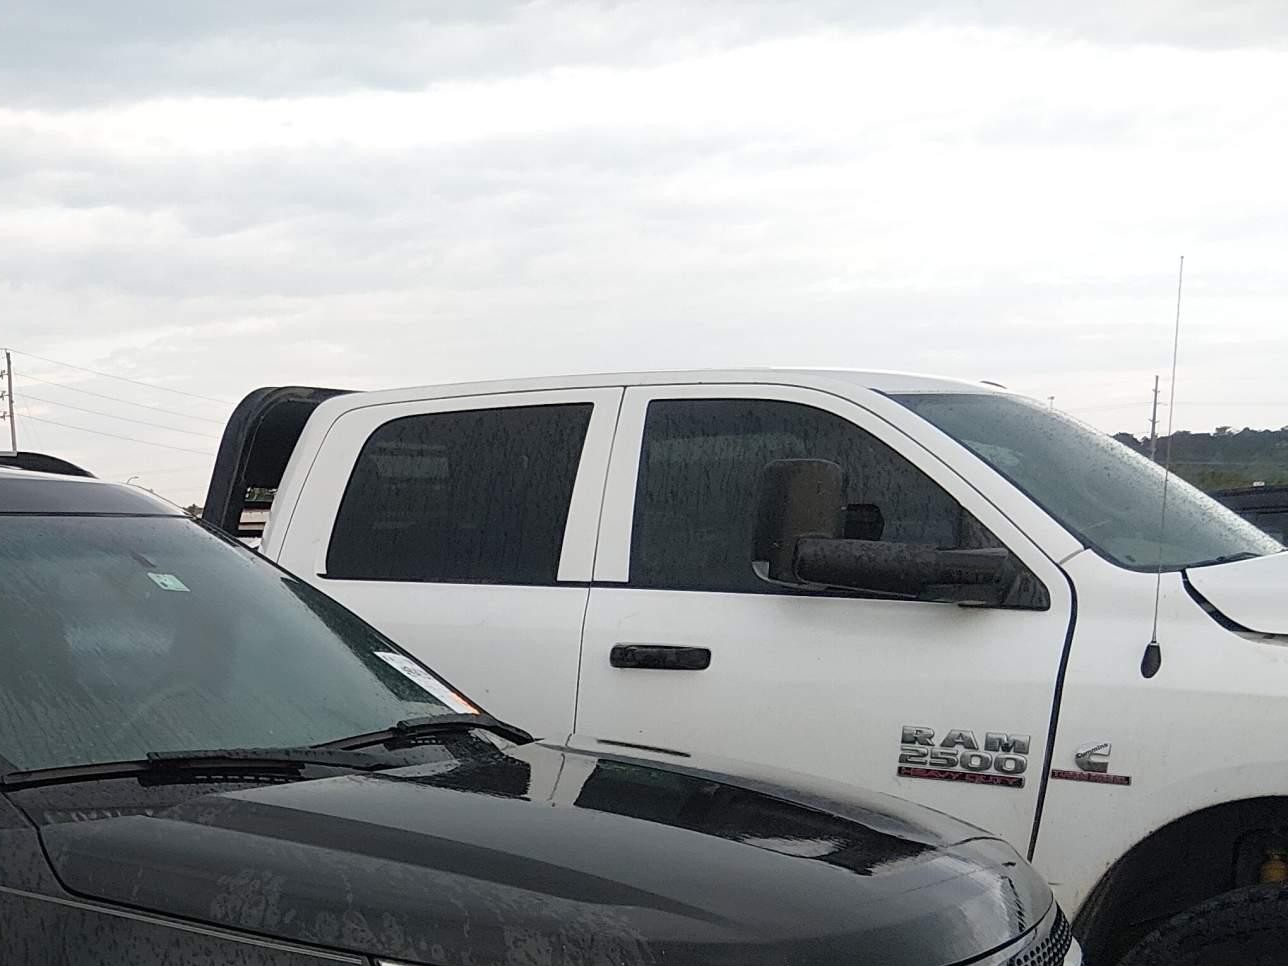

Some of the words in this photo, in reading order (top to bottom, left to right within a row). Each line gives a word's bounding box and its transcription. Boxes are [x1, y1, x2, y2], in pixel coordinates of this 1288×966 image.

[901, 725, 1031, 754] RAM
[1075, 743, 1109, 759] Cummins
[898, 745, 1028, 775] 2500
